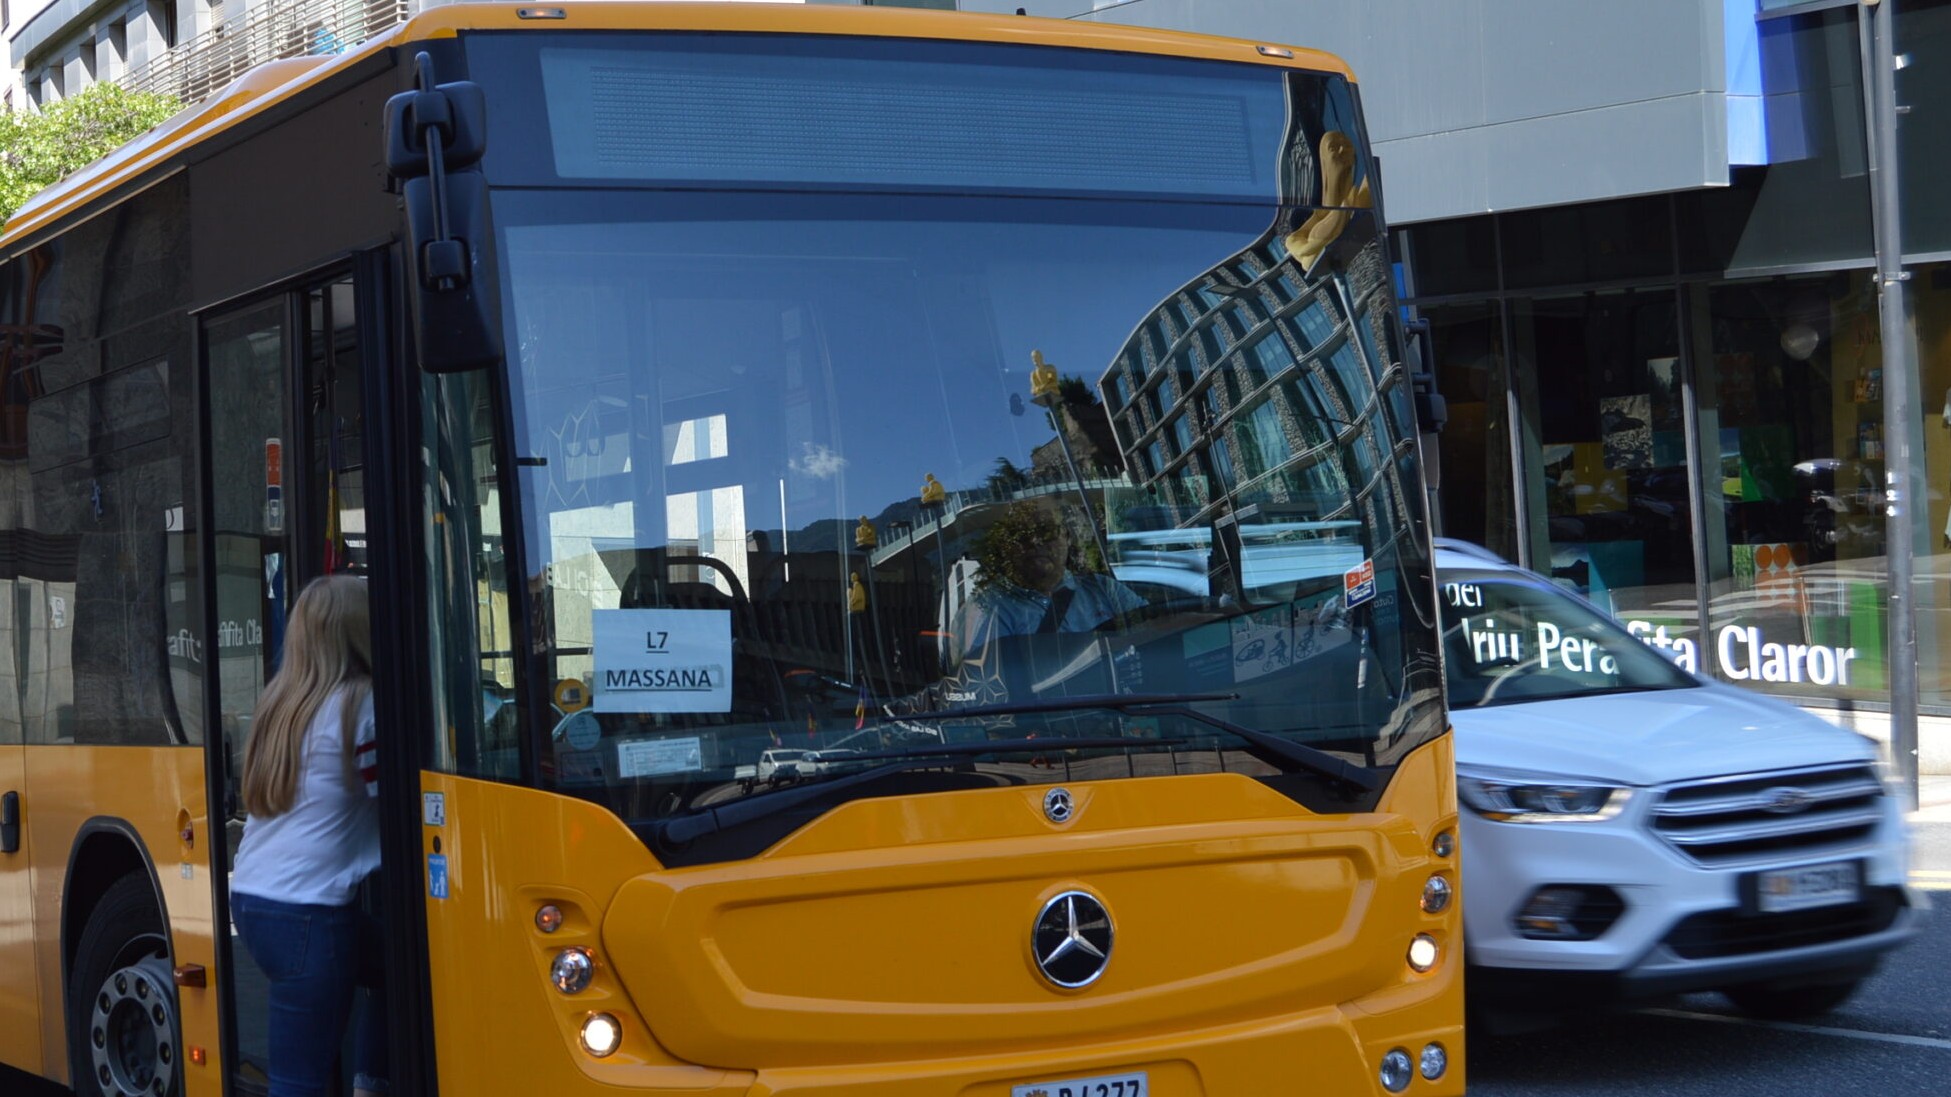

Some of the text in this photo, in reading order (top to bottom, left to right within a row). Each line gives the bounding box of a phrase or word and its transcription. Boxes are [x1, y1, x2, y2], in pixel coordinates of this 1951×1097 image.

[646, 631, 669, 649] L7
[1718, 625, 1855, 686] Claror
[606, 669, 712, 688] MASSANA
